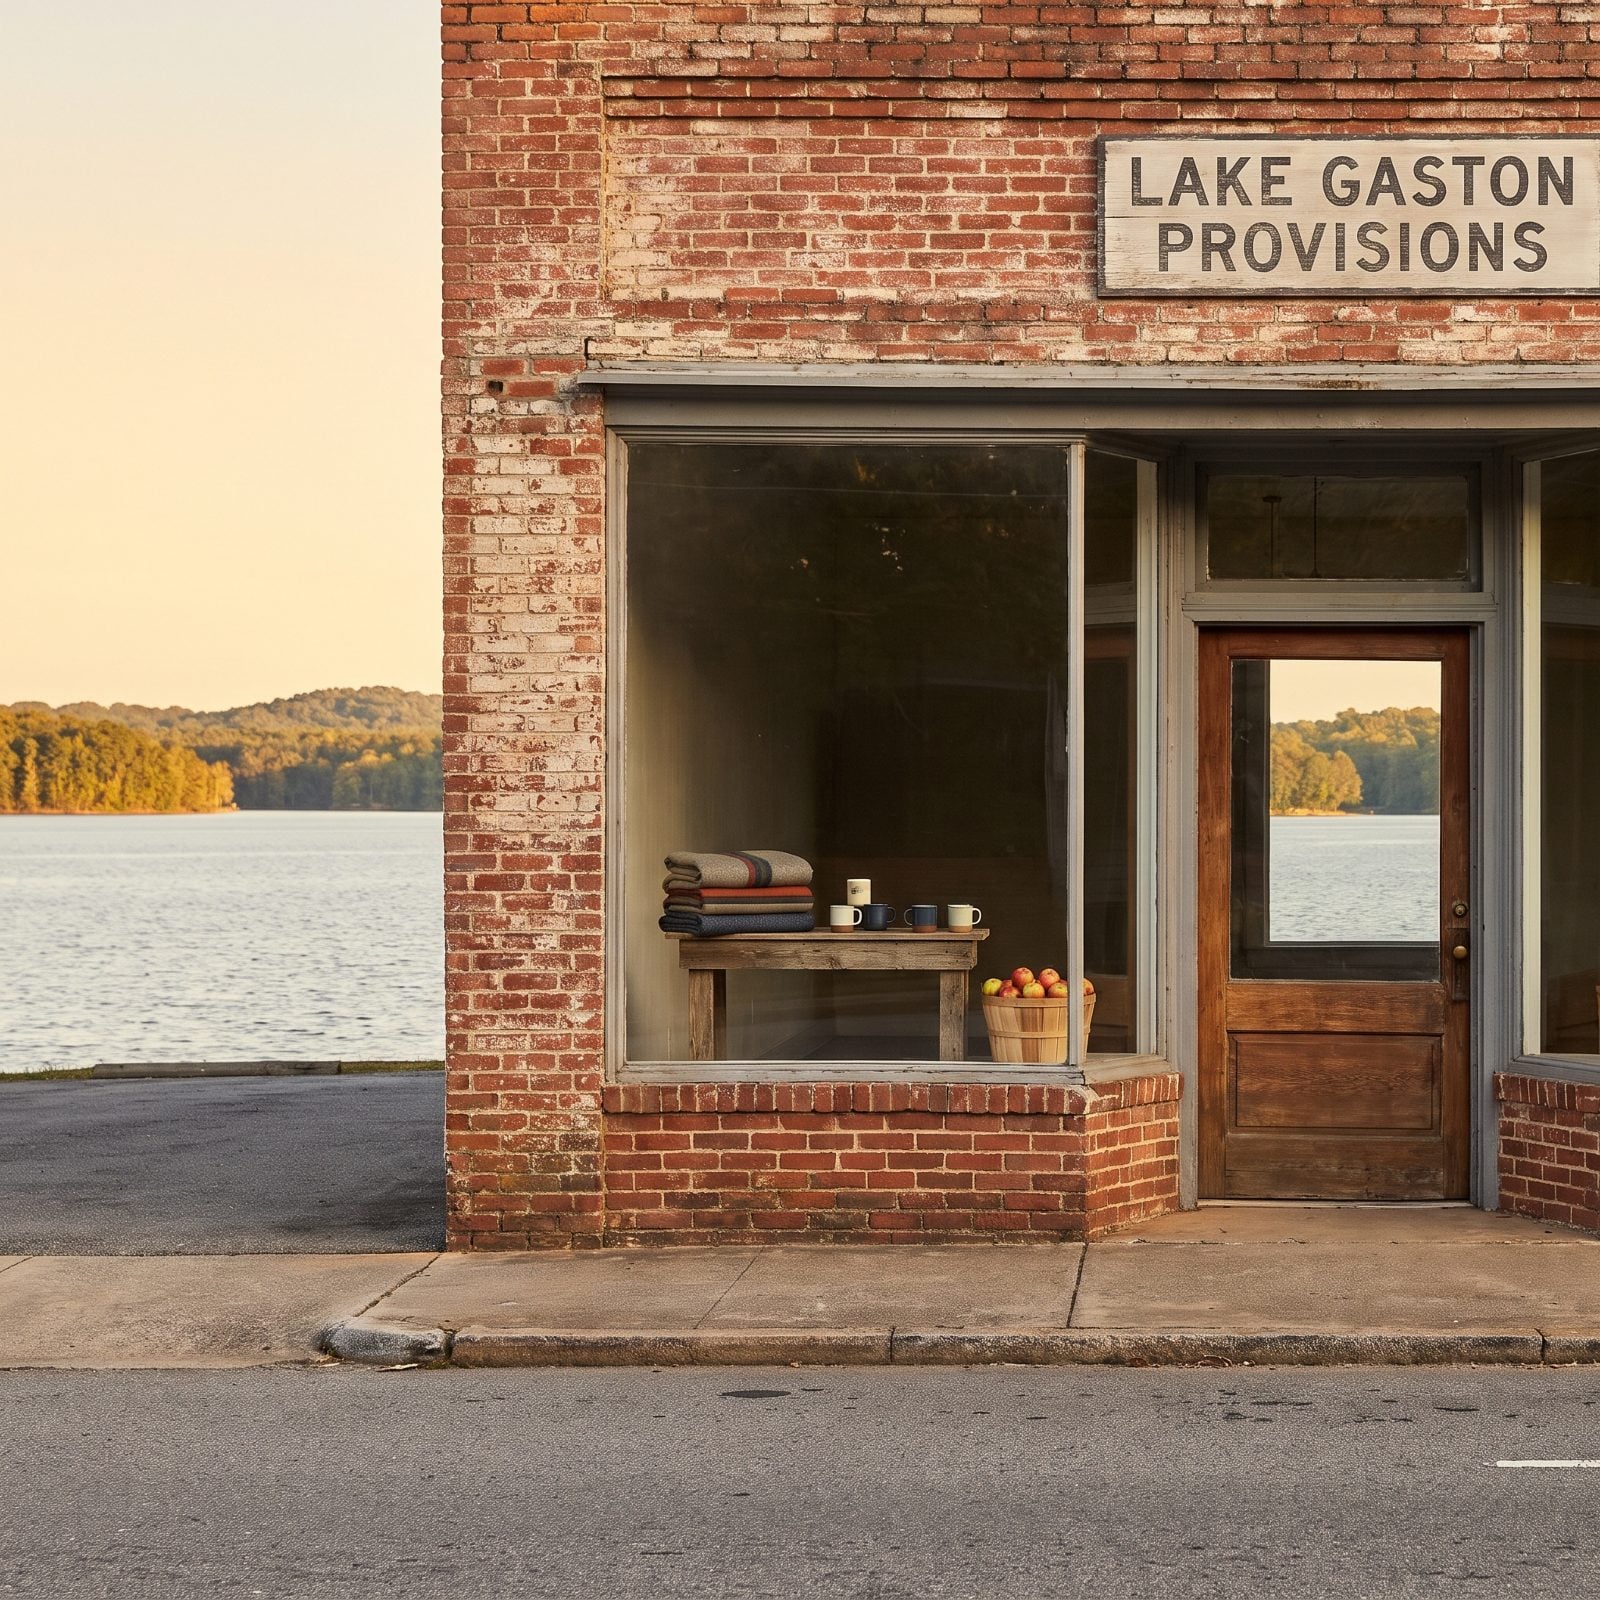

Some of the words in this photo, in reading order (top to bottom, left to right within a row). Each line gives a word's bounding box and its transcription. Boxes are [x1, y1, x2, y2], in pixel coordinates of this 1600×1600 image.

[1131, 156, 1293, 206] LAKE
[1323, 156, 1574, 206] GASTON
[1158, 222, 1548, 272] PROVISIONS
